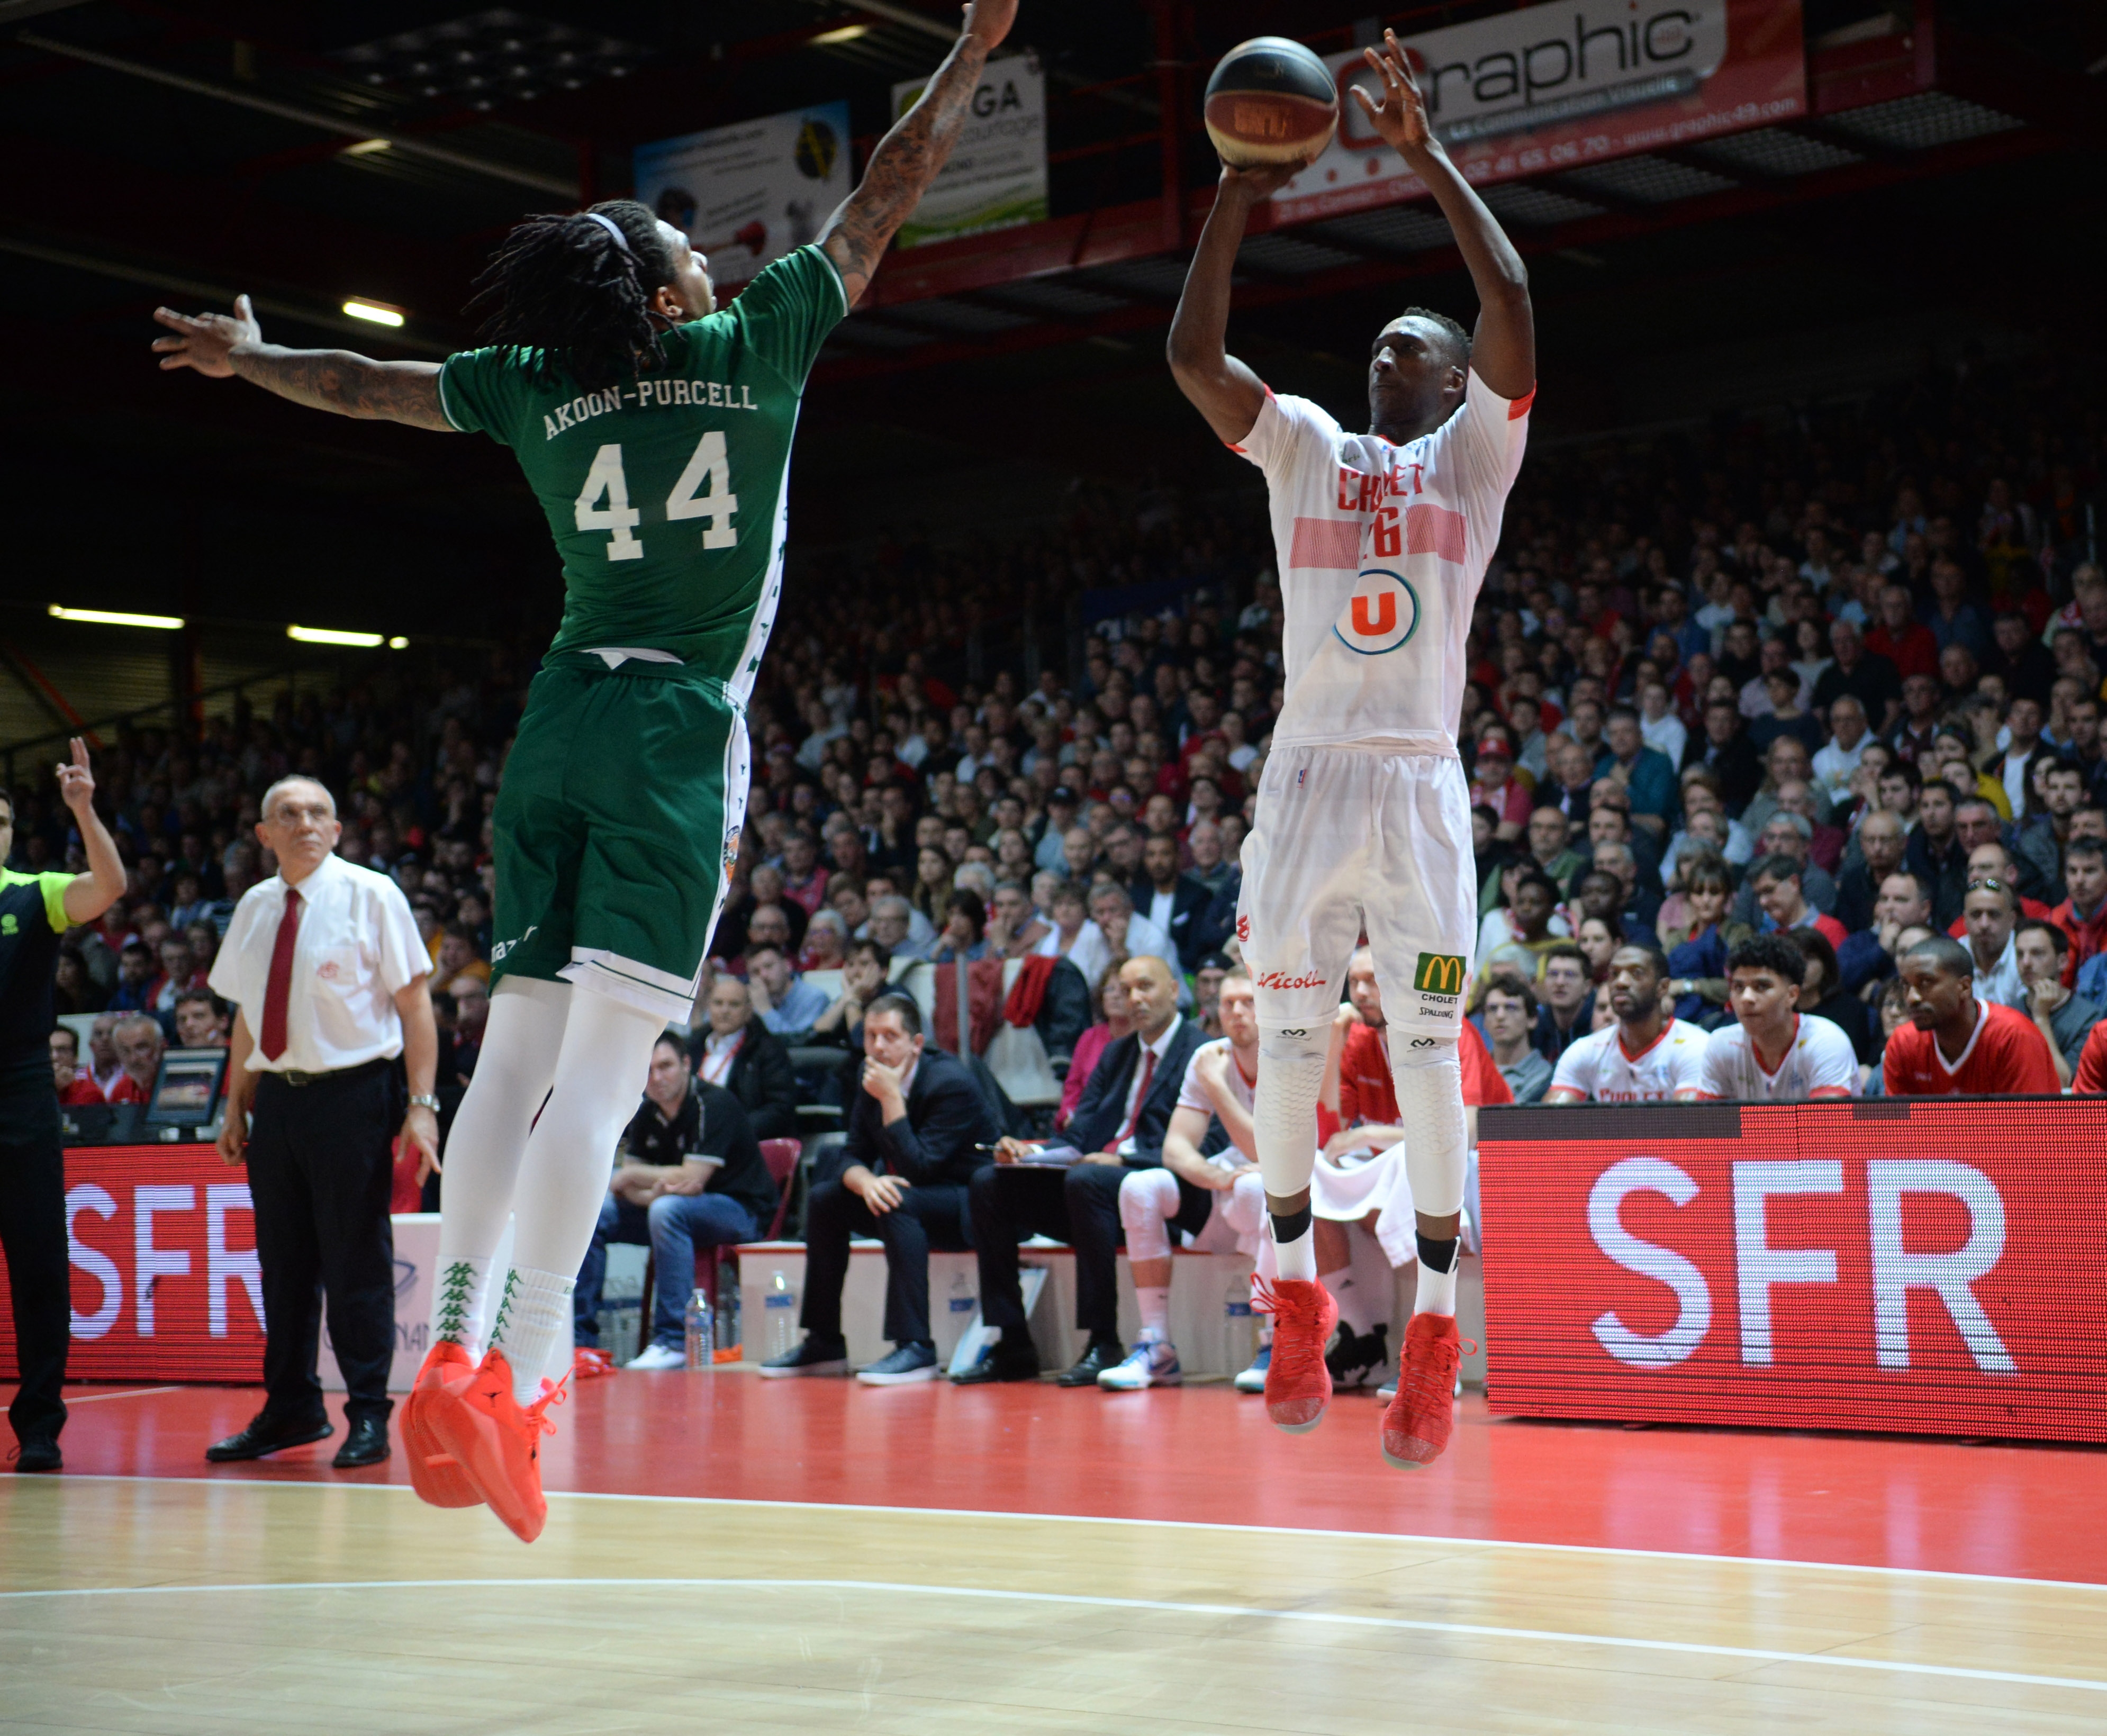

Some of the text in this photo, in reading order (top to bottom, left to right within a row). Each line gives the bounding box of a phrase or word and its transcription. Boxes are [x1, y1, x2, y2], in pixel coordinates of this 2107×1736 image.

[543, 379, 758, 440] AKOON-PURCELL
[575, 431, 738, 561] 44
[1419, 1007, 1454, 1019] SPALDING
[1421, 993, 1458, 1004] CHOLET
[64, 1184, 267, 1339] SFR
[1587, 1156, 2019, 1377] SFR
